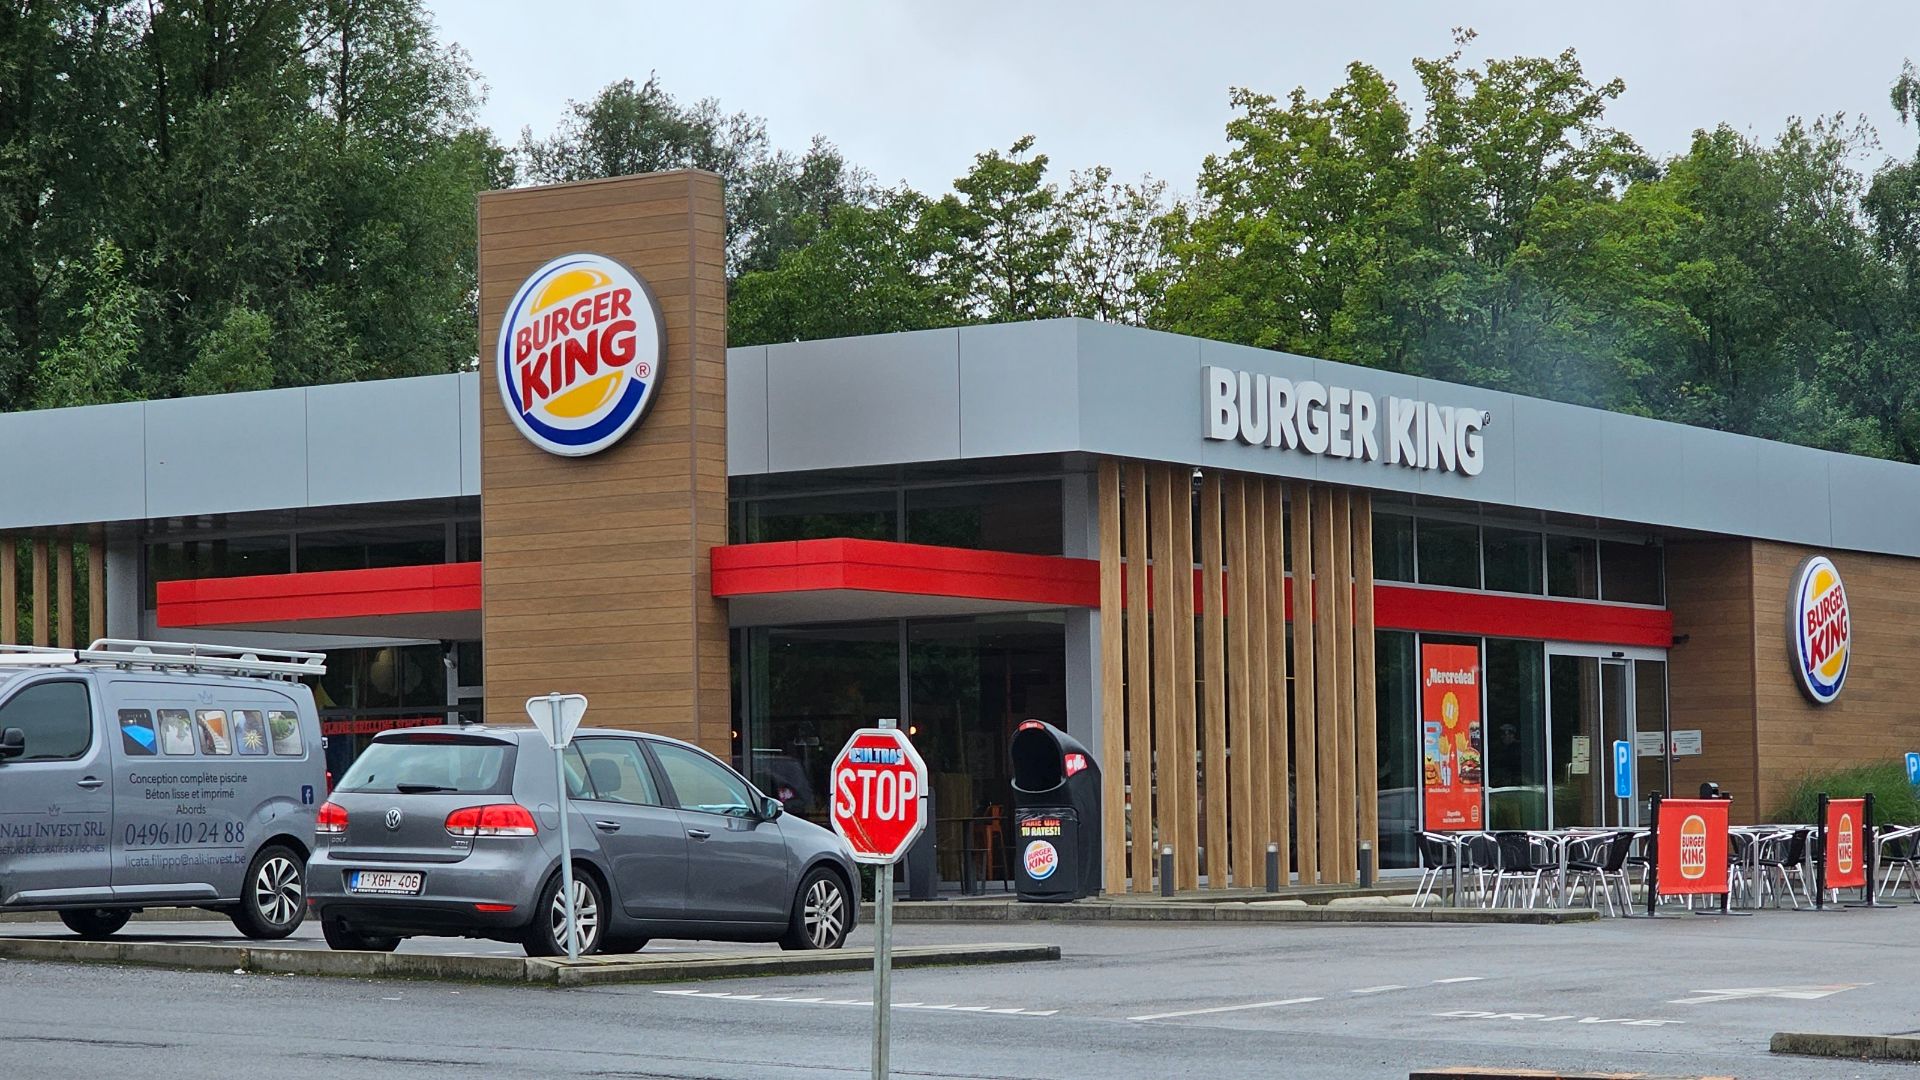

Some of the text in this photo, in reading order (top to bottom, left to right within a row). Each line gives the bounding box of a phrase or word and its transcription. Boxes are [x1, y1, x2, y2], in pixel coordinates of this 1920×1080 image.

[516, 288, 632, 365] BURGER
[521, 320, 637, 412] KING
[1202, 365, 1378, 461] BURGER
[1383, 395, 1484, 476] KING
[1807, 584, 1845, 637] BURGER
[1810, 607, 1848, 673] KING
[1426, 668, 1475, 687] Mercredeal
[1619, 746, 1628, 775] P
[1909, 757, 1918, 780] P
[129, 773, 248, 785] Conception complète piscine
[146, 788, 235, 801] Béton lisse et imprimé
[837, 768, 917, 820] STOP
[176, 804, 206, 815] Abords
[83, 821, 105, 836] SRL
[125, 821, 245, 846] 0496 10 24 88
[1021, 827, 1030, 836] TU
[1682, 836, 1704, 848] BURGER
[1027, 847, 1052, 861] BURGER
[1682, 848, 1704, 865] KING
[1838, 844, 1852, 859] KING
[1028, 854, 1053, 870] KING
